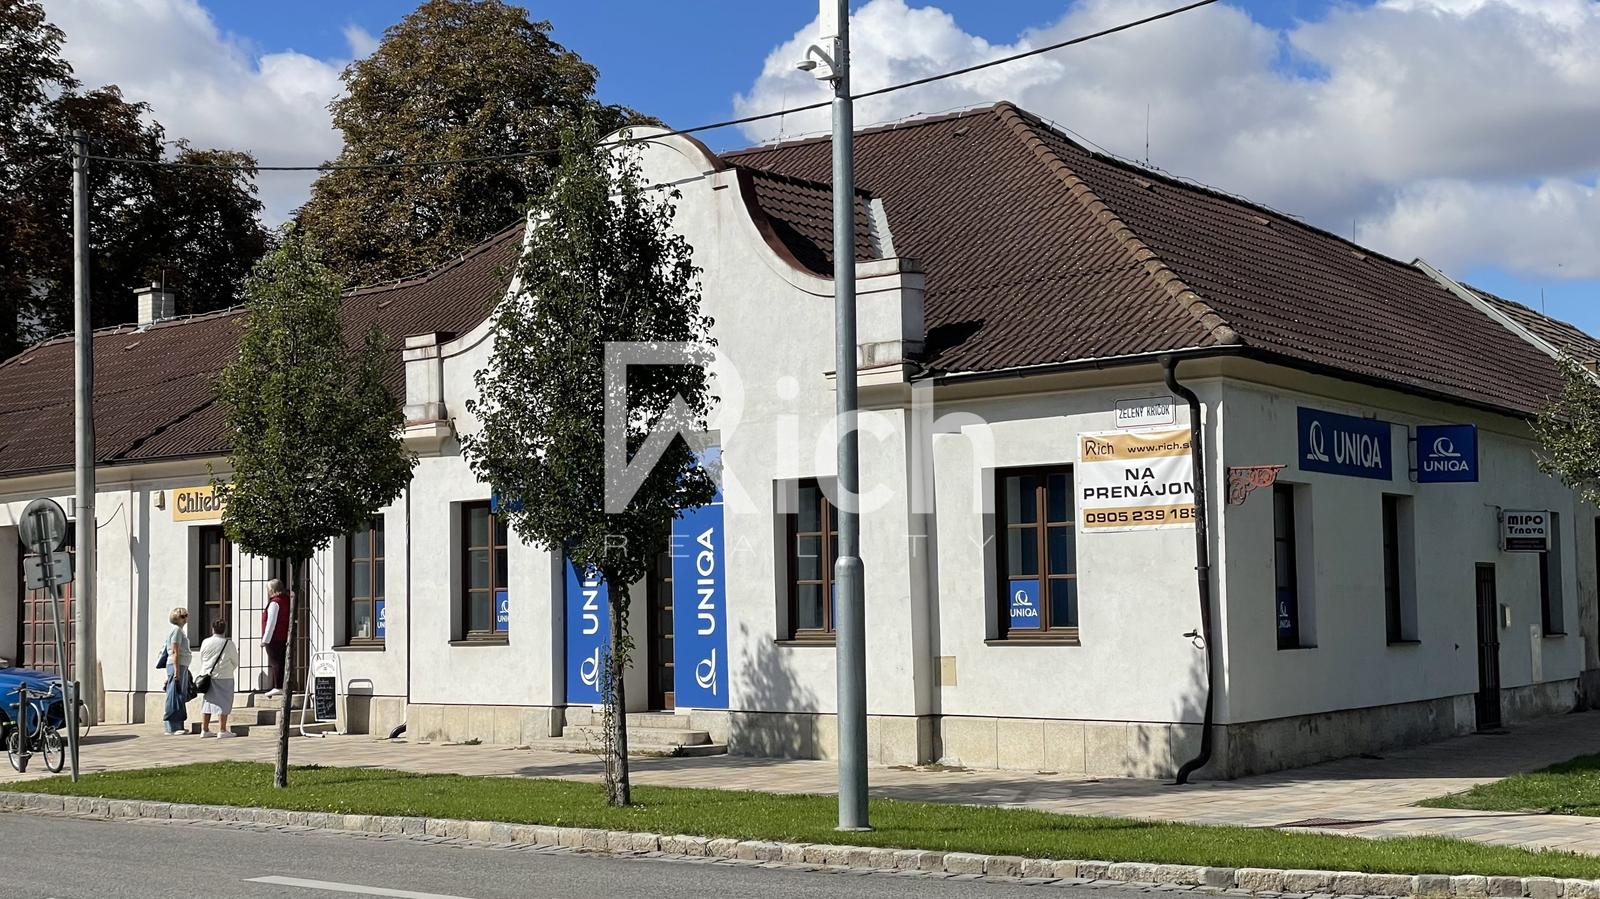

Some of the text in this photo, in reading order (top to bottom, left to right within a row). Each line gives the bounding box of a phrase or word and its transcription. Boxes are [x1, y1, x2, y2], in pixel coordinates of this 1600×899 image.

[1085, 440, 1115, 456] Rich
[1334, 430, 1382, 469] UNIQA
[1424, 460, 1469, 472] UNIQA
[1125, 467, 1154, 480] NA
[177, 490, 221, 513] Chlieb
[1086, 511, 1128, 523] 0905
[1132, 509, 1165, 522] 239
[1507, 515, 1544, 525] MIPO
[1507, 526, 1544, 535] Trnava
[696, 527, 716, 635] UNIQA
[1010, 608, 1038, 617] UNIQA
